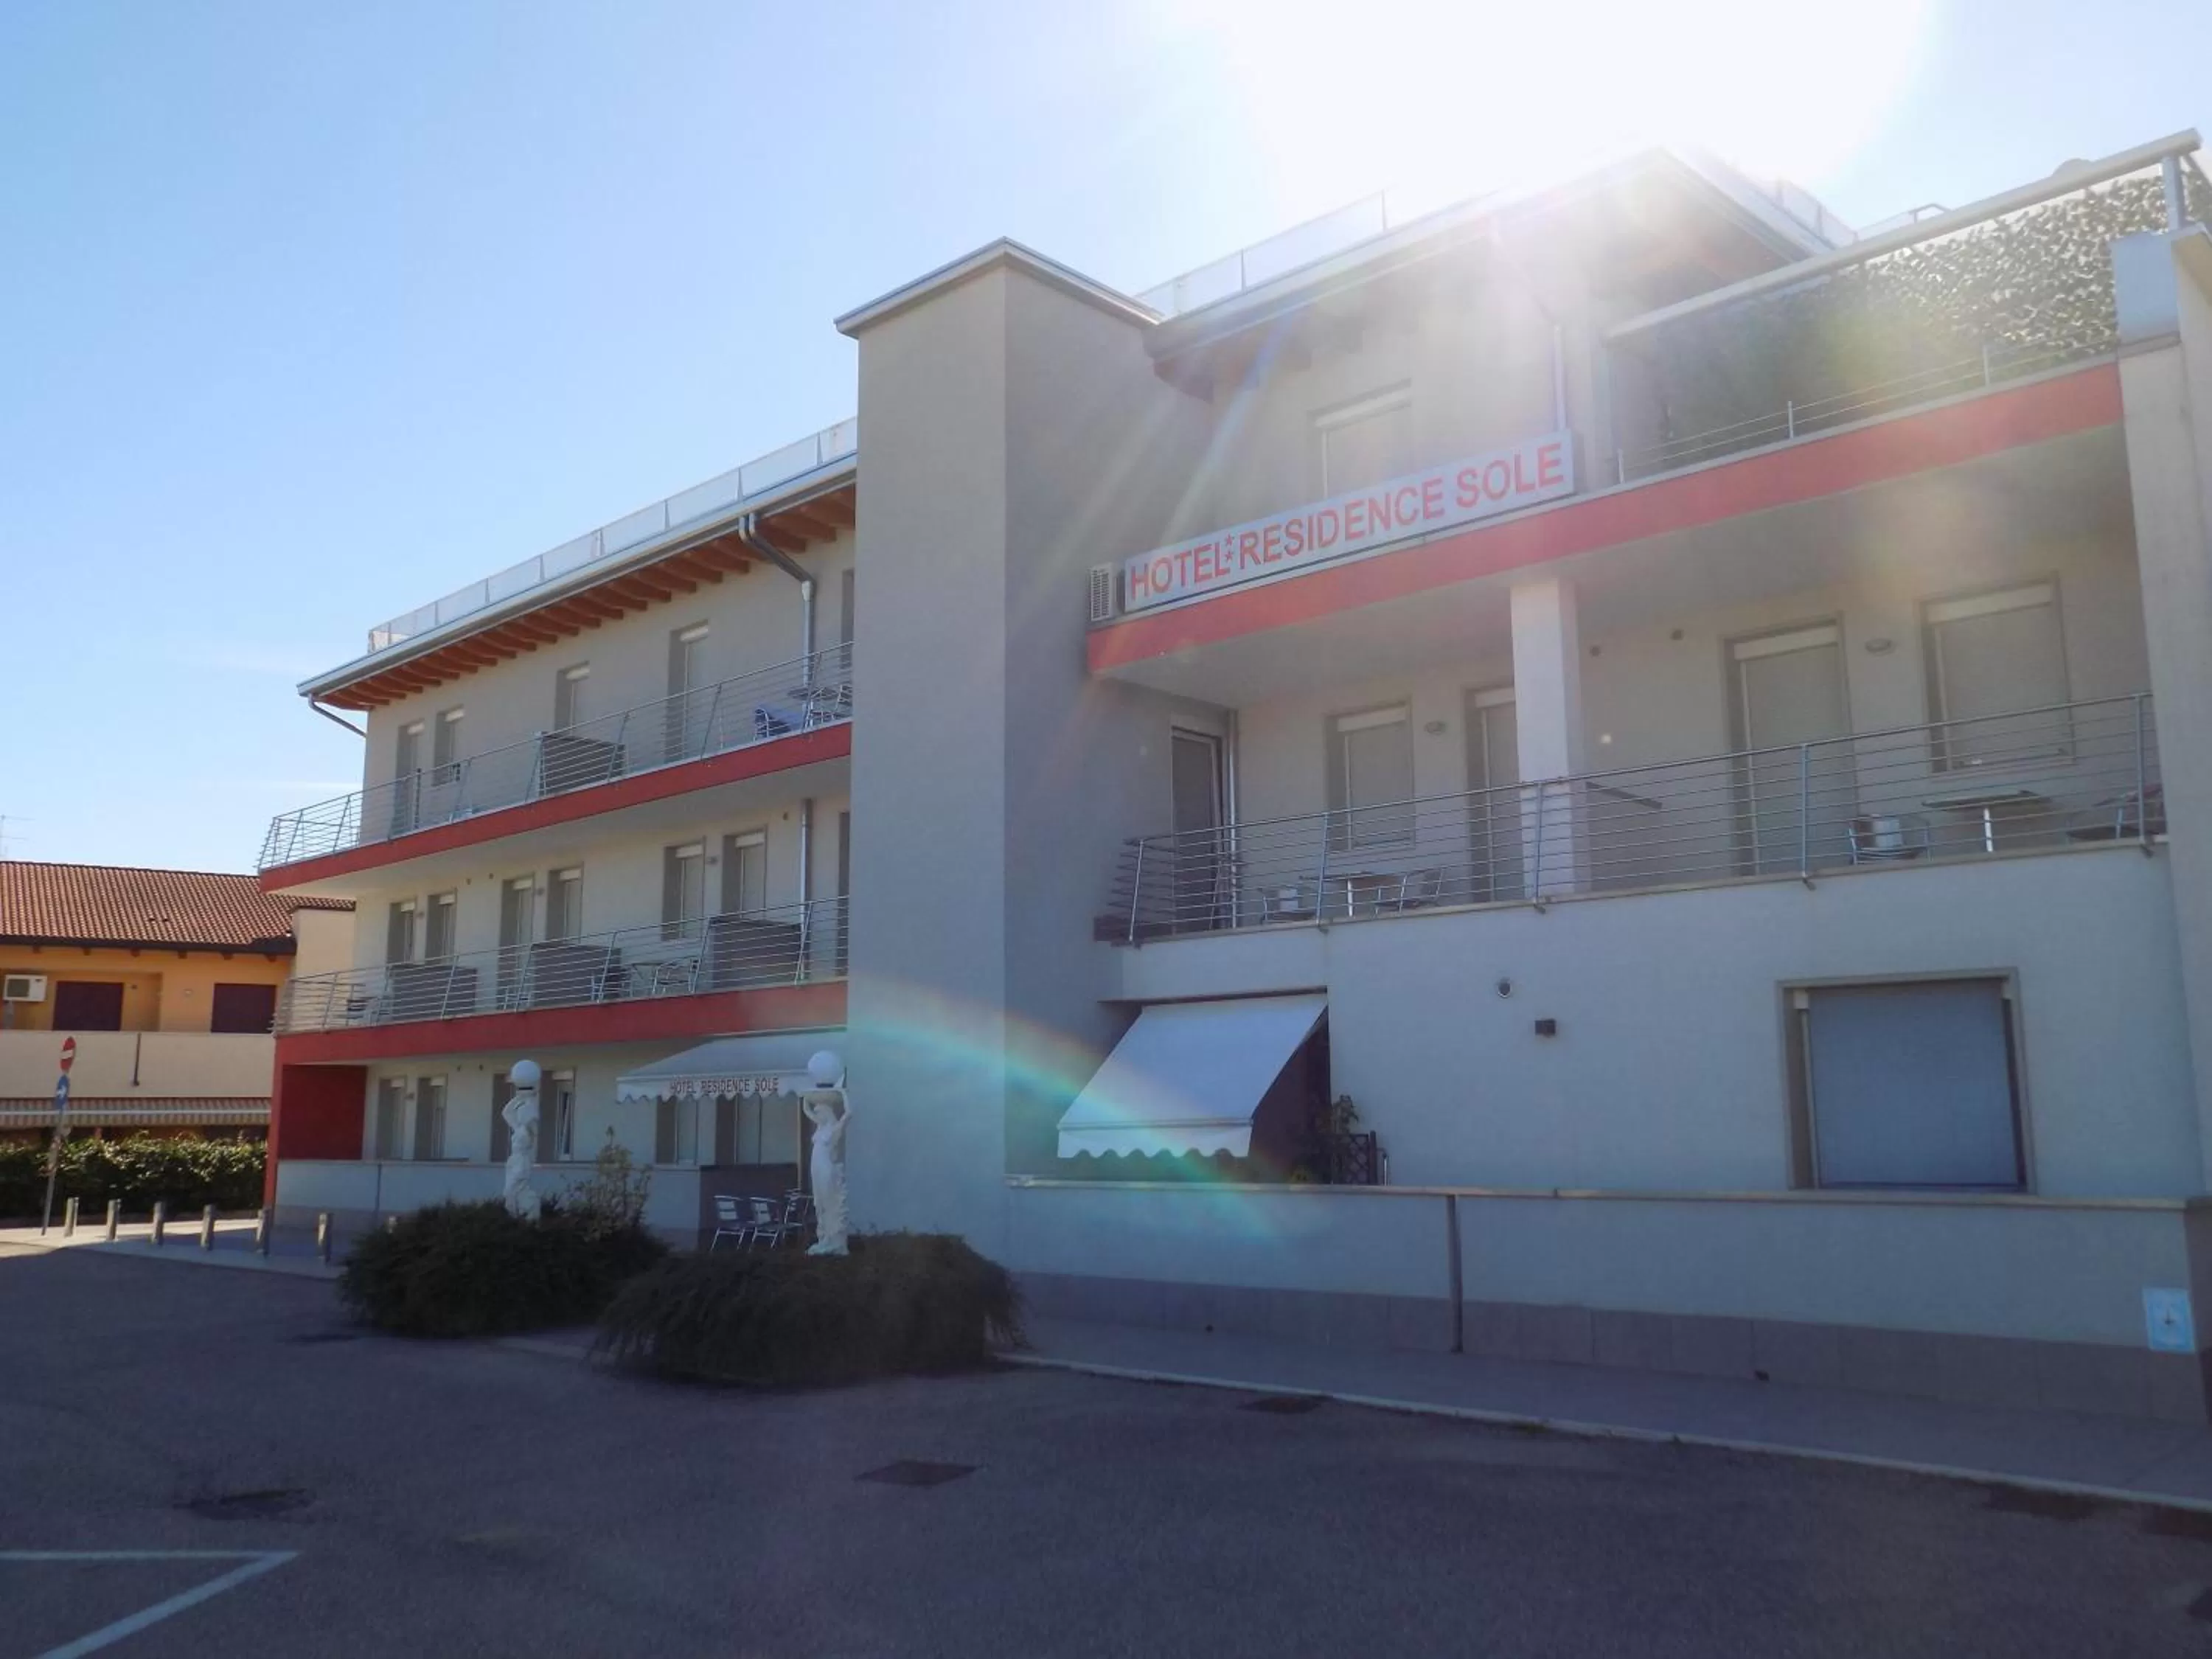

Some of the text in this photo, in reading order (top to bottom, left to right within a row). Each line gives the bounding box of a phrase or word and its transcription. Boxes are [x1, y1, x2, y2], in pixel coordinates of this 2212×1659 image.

[1130, 442, 1565, 599] HOTEL RESIDENCE SOLE
[669, 1077, 779, 1095] HOTEL RESIDENCE SOLE
